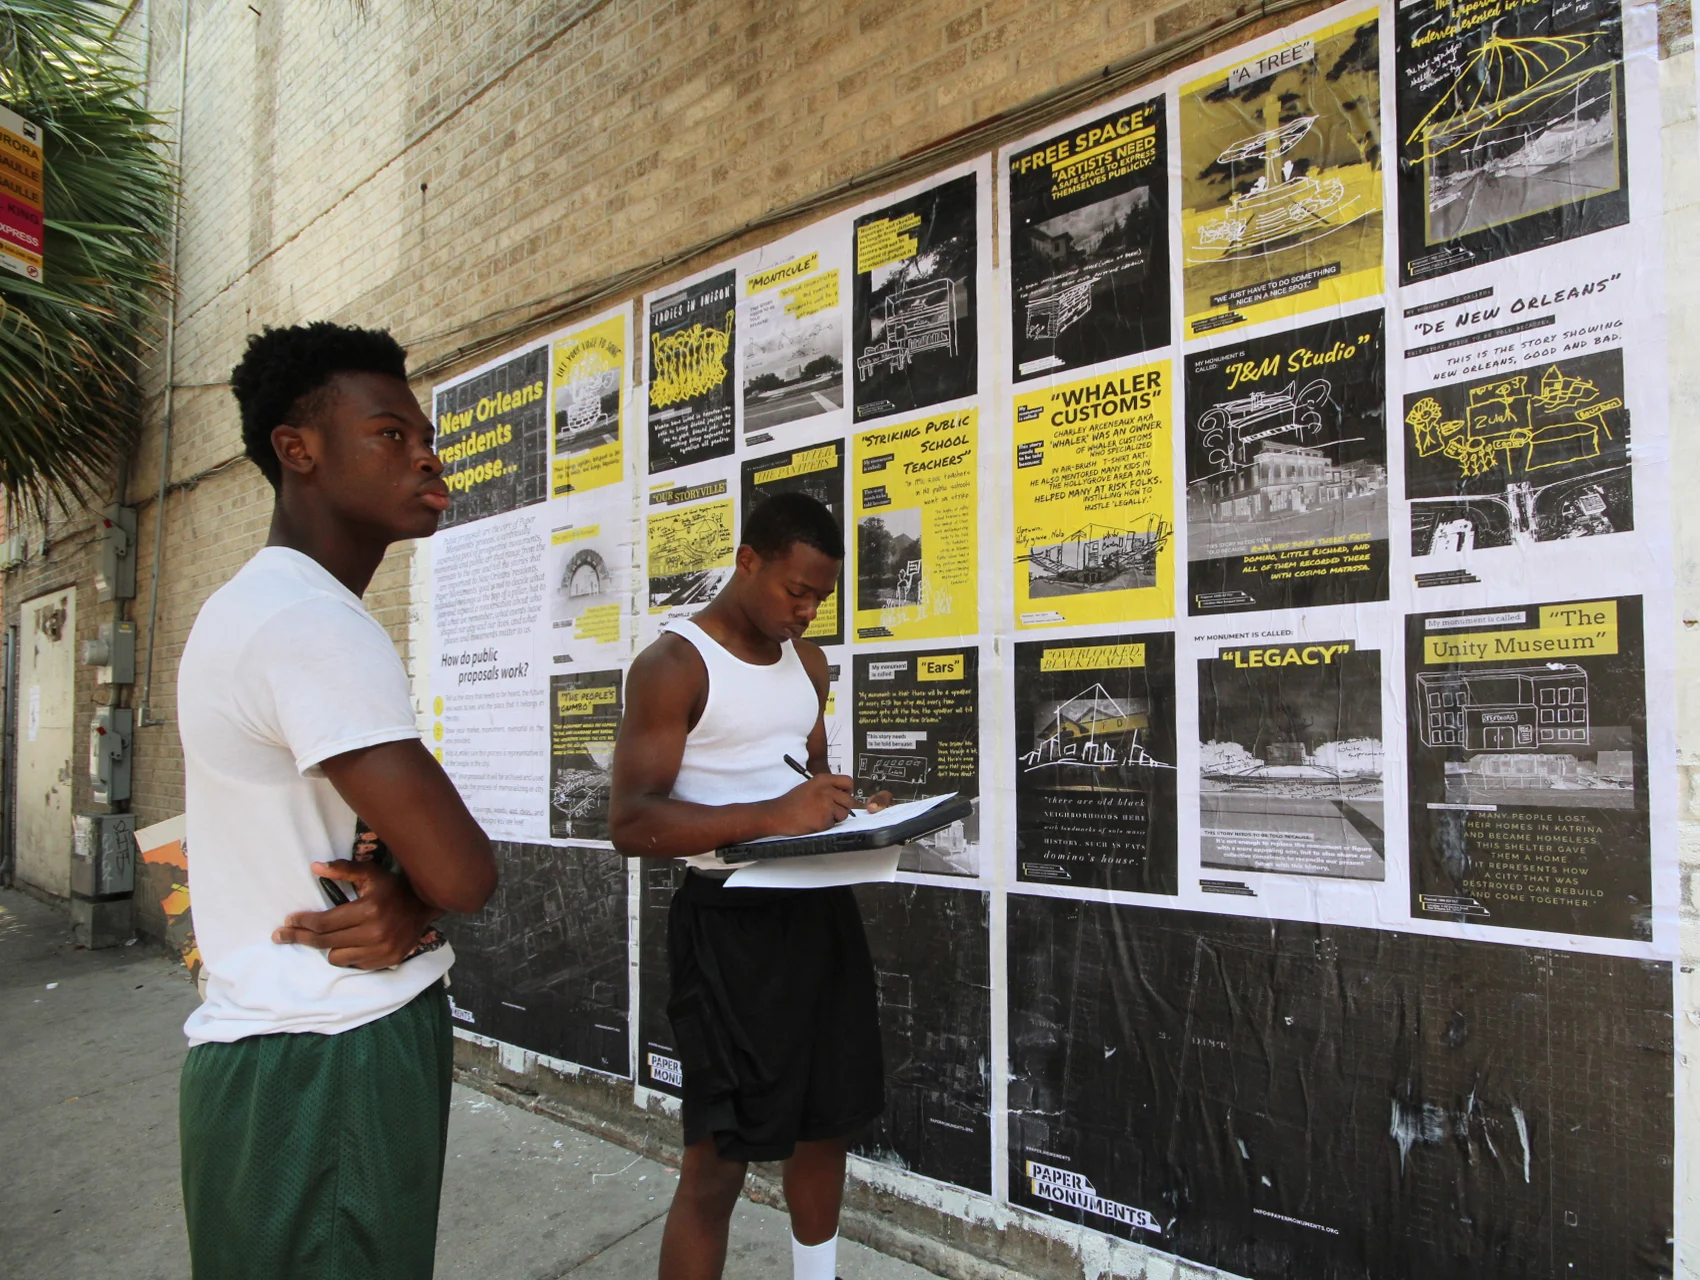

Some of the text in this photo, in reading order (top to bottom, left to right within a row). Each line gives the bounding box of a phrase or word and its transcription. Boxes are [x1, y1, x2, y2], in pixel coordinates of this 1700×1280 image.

[1233, 41, 1310, 83] "A TREE"
[1011, 107, 1153, 175] "FREE SPACE"
[0, 154, 38, 182] AULLE
[1051, 147, 1156, 193] A SAFE SPACE TO EXPRESS
[1052, 136, 1156, 183] "ARTISTS NEED
[0, 177, 38, 203] AULLE
[1052, 156, 1156, 201] THEMSELVES PUBLICLY."
[748, 255, 817, 290] "MONTICULE"
[1213, 266, 1337, 304] "WE JUST HAVE TO DO SOMETHING
[1236, 296, 1253, 306] NICE
[1270, 287, 1288, 298] NICE
[1414, 273, 1621, 336] "DE NEW ORLEANS"
[1447, 319, 1623, 366] THIS IS THE STORY SHOWING
[1194, 360, 1204, 368] MY
[1205, 353, 1239, 365] MONUMENT
[1195, 364, 1219, 373] CALLED:
[1225, 334, 1371, 390] "J&M Studio"
[1433, 334, 1622, 381] NEW ORLEANS, GOOD AND BAD.
[1051, 370, 1161, 408] "WHALER
[439, 381, 543, 438] New Orleans
[1051, 390, 1161, 427] CUSTOMS"
[862, 416, 970, 447] "STRIKING PUBLIC
[1053, 413, 1154, 439] CHARLEY ARCENEAUX AKA
[1092, 430, 1110, 442] WAS
[1112, 427, 1127, 437] AN
[1129, 421, 1162, 434] OWNER
[439, 423, 512, 464] residents
[797, 447, 832, 462] "AFTER
[921, 434, 969, 453] SCHOOL
[1076, 432, 1152, 455] OF WHALER CUSTOMS
[1107, 441, 1152, 455] SPECIALIZED
[903, 450, 971, 474] TEACHERS"
[757, 472, 776, 483] THE
[1030, 478, 1040, 487] HE
[1041, 475, 1060, 485] ALSO
[1061, 470, 1099, 481] MENTORED
[1101, 465, 1121, 475] MANY
[1124, 462, 1141, 470] KIDS
[652, 491, 674, 503] "OUR
[1034, 476, 1162, 503] HELPED MANY AT RISK FOLKS.
[1085, 501, 1111, 511] HUSTLE
[1243, 544, 1370, 564] DOMINO, LITTLE RICHARD, AND
[1243, 553, 1371, 574] ALL OF THEM RECORDED THERE
[1271, 564, 1371, 580] WITH COSIMO MATASSA.
[1428, 620, 1441, 629] My
[1442, 617, 1486, 627] monument
[1496, 613, 1523, 623] called:
[1550, 609, 1606, 627] "The
[1207, 632, 1249, 642] MONUMENT
[1261, 630, 1294, 638] CALLED:
[1433, 631, 1607, 659] Unity Museum"
[441, 647, 498, 668] How do public
[1044, 653, 1142, 670] BLACK PLACES"
[1048, 645, 1139, 659] "OVERLOOKED
[1222, 645, 1350, 669] "LEGACY"
[458, 662, 529, 687] proposals work?
[922, 660, 960, 674] "Ears"
[1097, 797, 1113, 806] old
[1117, 797, 1146, 808] black
[1512, 813, 1553, 821] PEOPLE
[1463, 880, 1604, 897] DESTROYED CAN REBUILD
[1470, 891, 1491, 899] AND
[1495, 893, 1525, 902] COME
[651, 1055, 679, 1072] PAPER
[1033, 1164, 1082, 1190] PAPER
[1038, 1182, 1147, 1226] MONUMENTS
